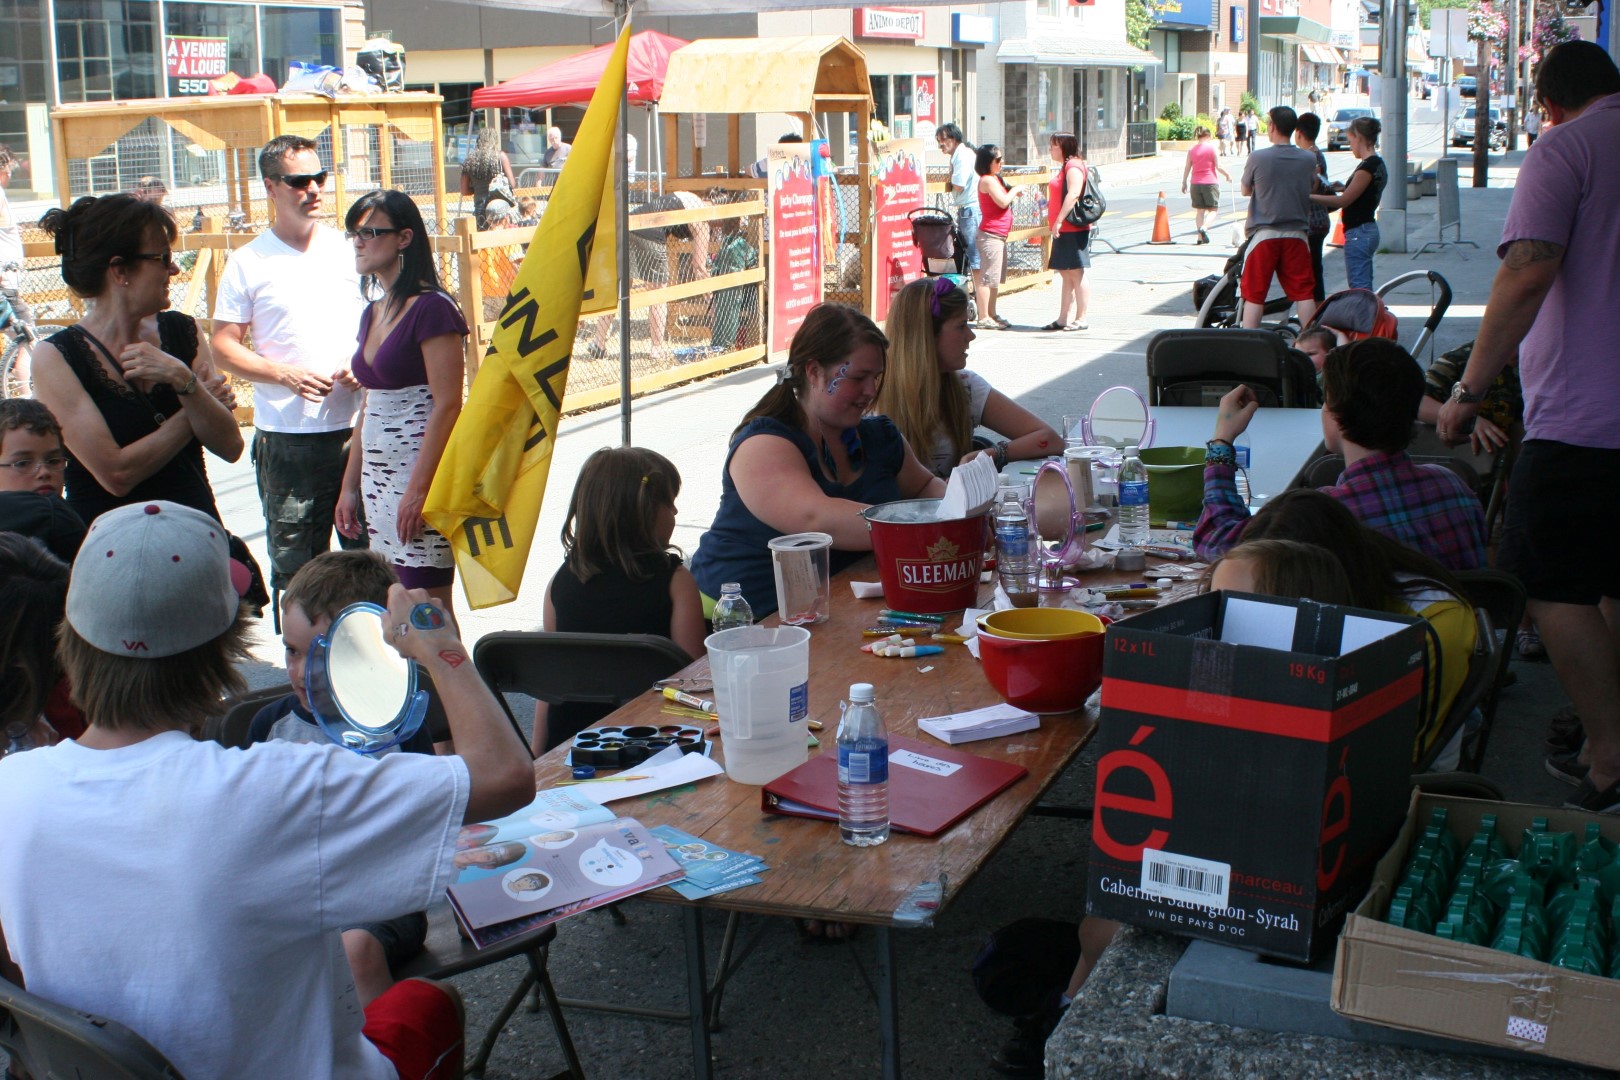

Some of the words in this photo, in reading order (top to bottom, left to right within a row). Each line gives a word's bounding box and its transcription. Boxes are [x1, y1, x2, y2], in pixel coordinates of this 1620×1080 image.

[868, 13, 894, 30] ANIMO
[182, 42, 227, 58] VENDRE
[190, 59, 226, 74] LOUER
[902, 559, 976, 584] SLEEMAN
[1113, 638, 1127, 652] 12
[1130, 643, 1137, 654] x
[1141, 641, 1156, 657] 1L
[1288, 662, 1304, 678] 19
[1306, 666, 1326, 685] Kg
[1092, 724, 1174, 863] é
[1230, 871, 1304, 896] marceau
[1148, 909, 1165, 920] VIN
[1170, 913, 1184, 924] DE
[1188, 917, 1214, 930] PAYS
[1256, 908, 1300, 932] Syrah
